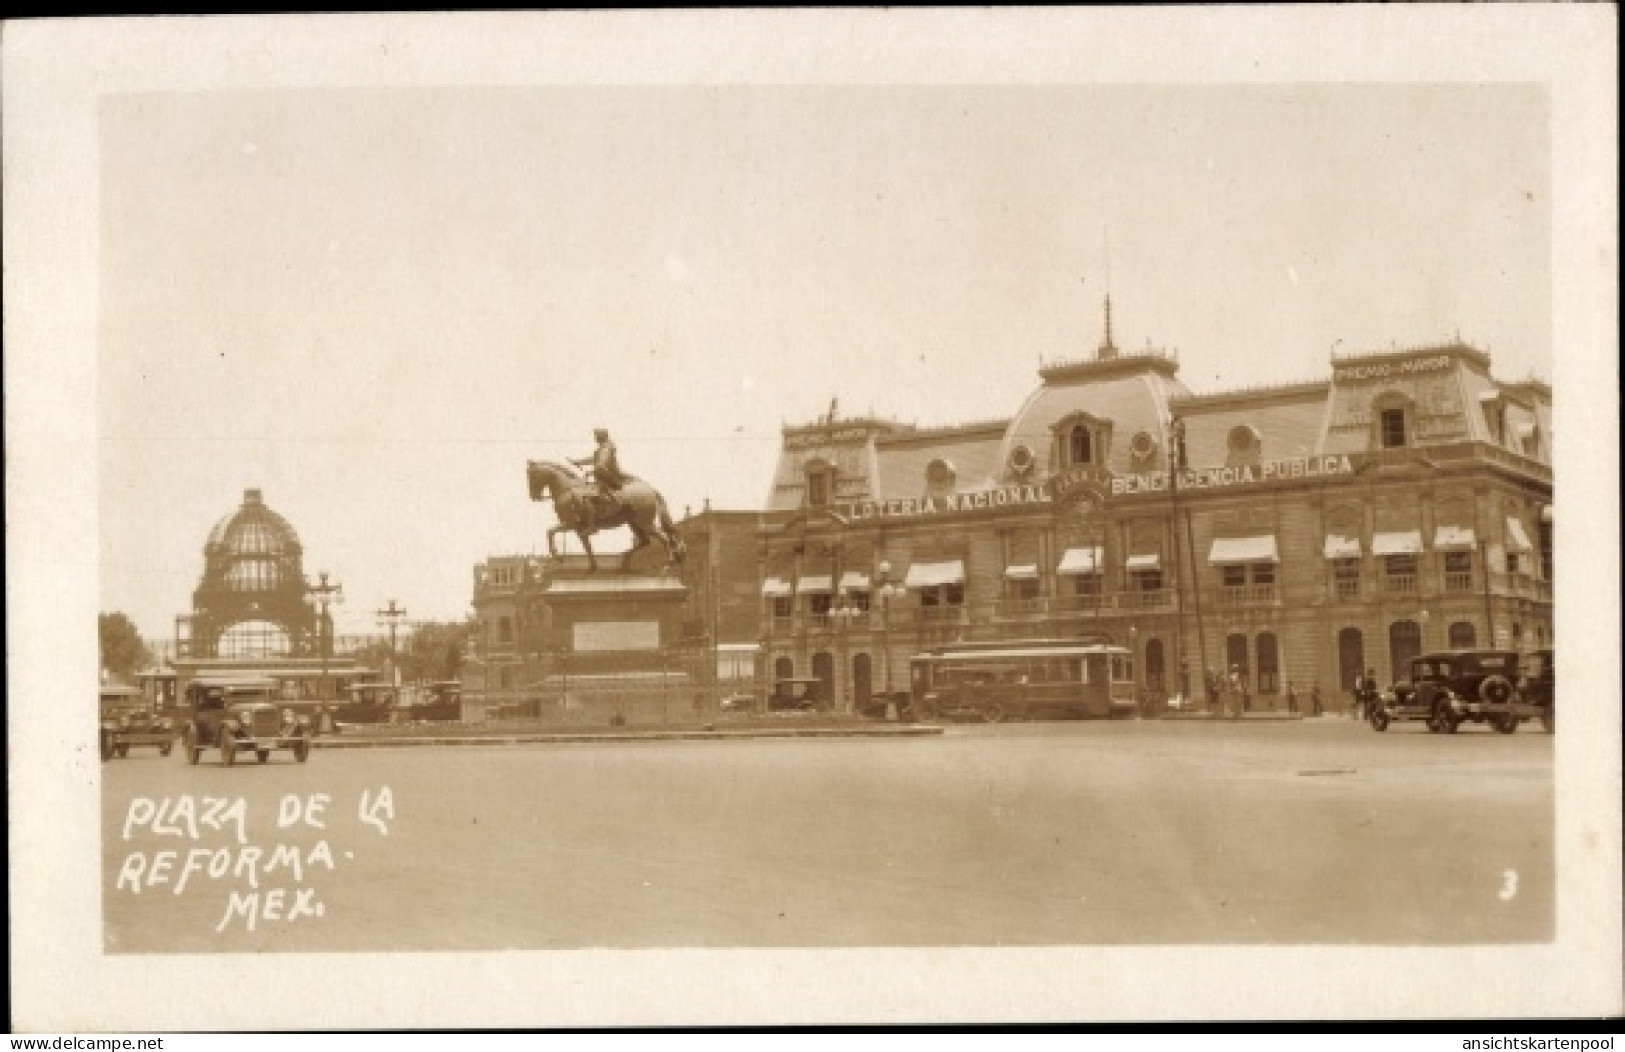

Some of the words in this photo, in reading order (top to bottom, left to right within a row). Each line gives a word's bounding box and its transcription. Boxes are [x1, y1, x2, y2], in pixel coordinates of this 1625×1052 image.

[1260, 456, 1354, 482] PUBLICA
[850, 495, 937, 519] LOTERIA
[946, 486, 1052, 512] NACIONAL
